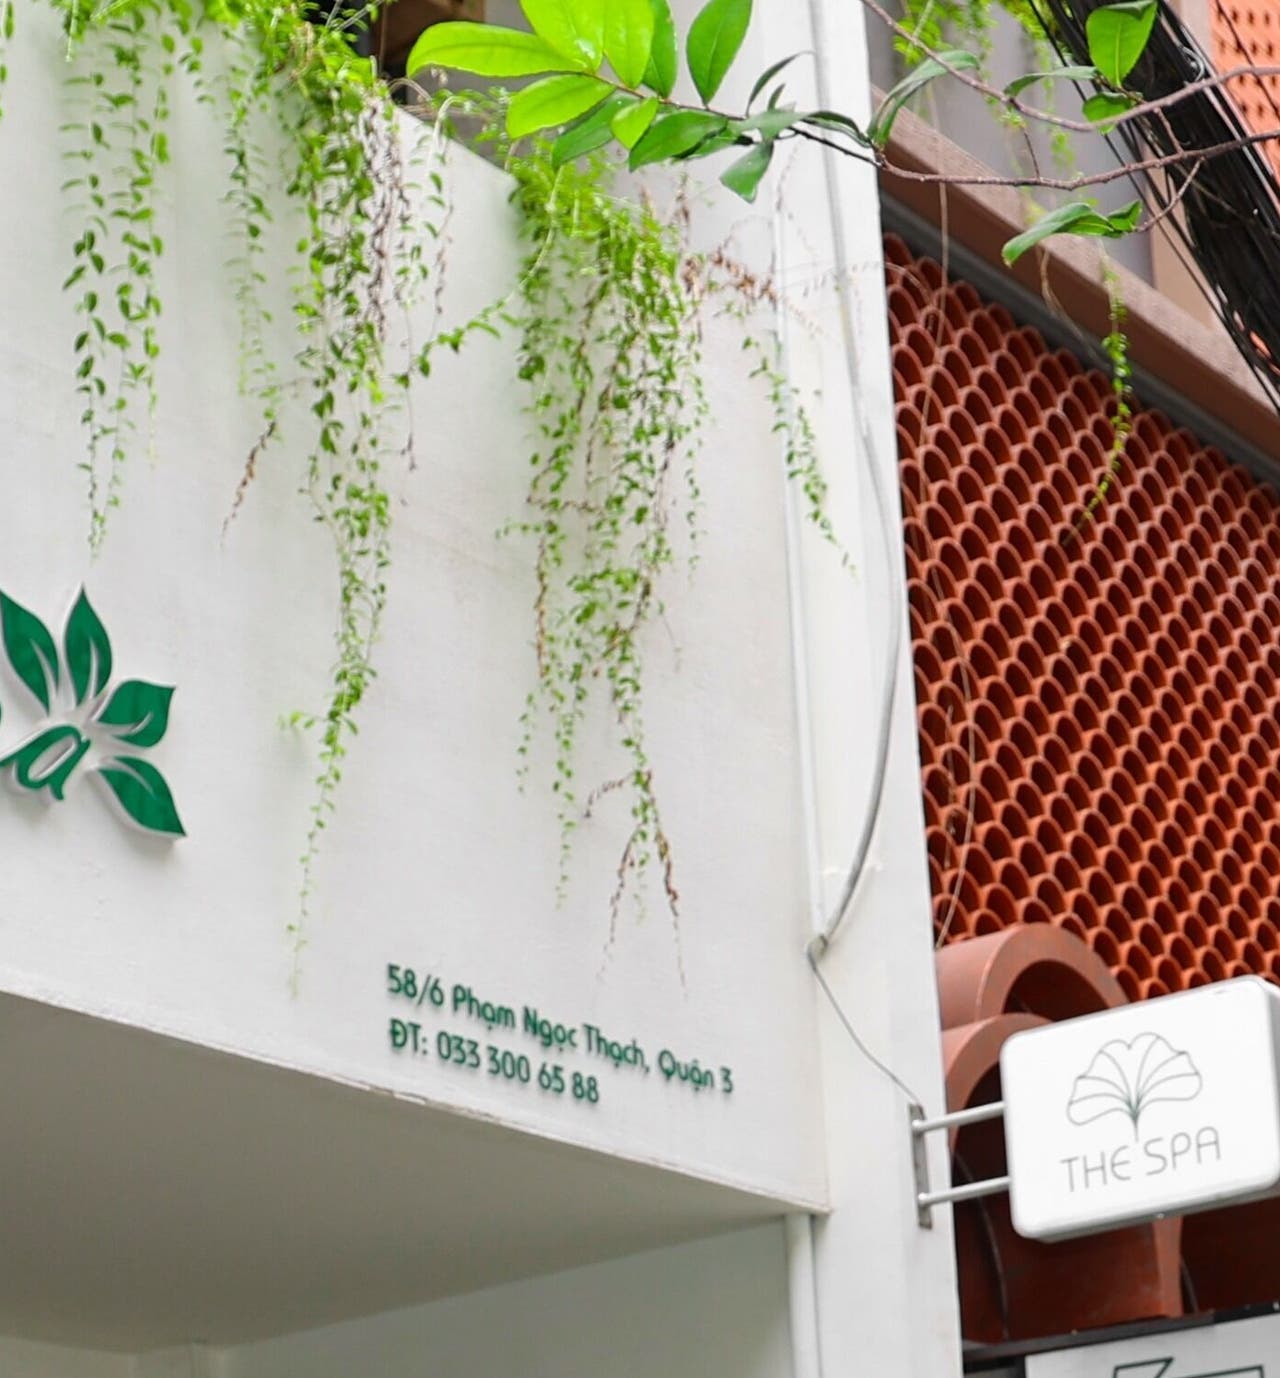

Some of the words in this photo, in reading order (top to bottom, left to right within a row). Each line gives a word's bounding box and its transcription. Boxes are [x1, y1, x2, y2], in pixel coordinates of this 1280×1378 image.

[387, 963, 445, 1008] 58/6
[452, 984, 515, 1029] Phạm
[523, 1006, 577, 1049] Ngọc
[582, 1023, 650, 1074] Thạch,
[658, 1049, 714, 1091] Quận
[721, 1066, 733, 1093] 3
[389, 1019, 428, 1055] ĐT:
[437, 1031, 481, 1069] 033
[487, 1046, 531, 1084] 300
[537, 1062, 565, 1095] 65
[571, 1071, 600, 1104] 88
[1059, 1144, 1132, 1193] THE
[1143, 1125, 1222, 1177] SPA
